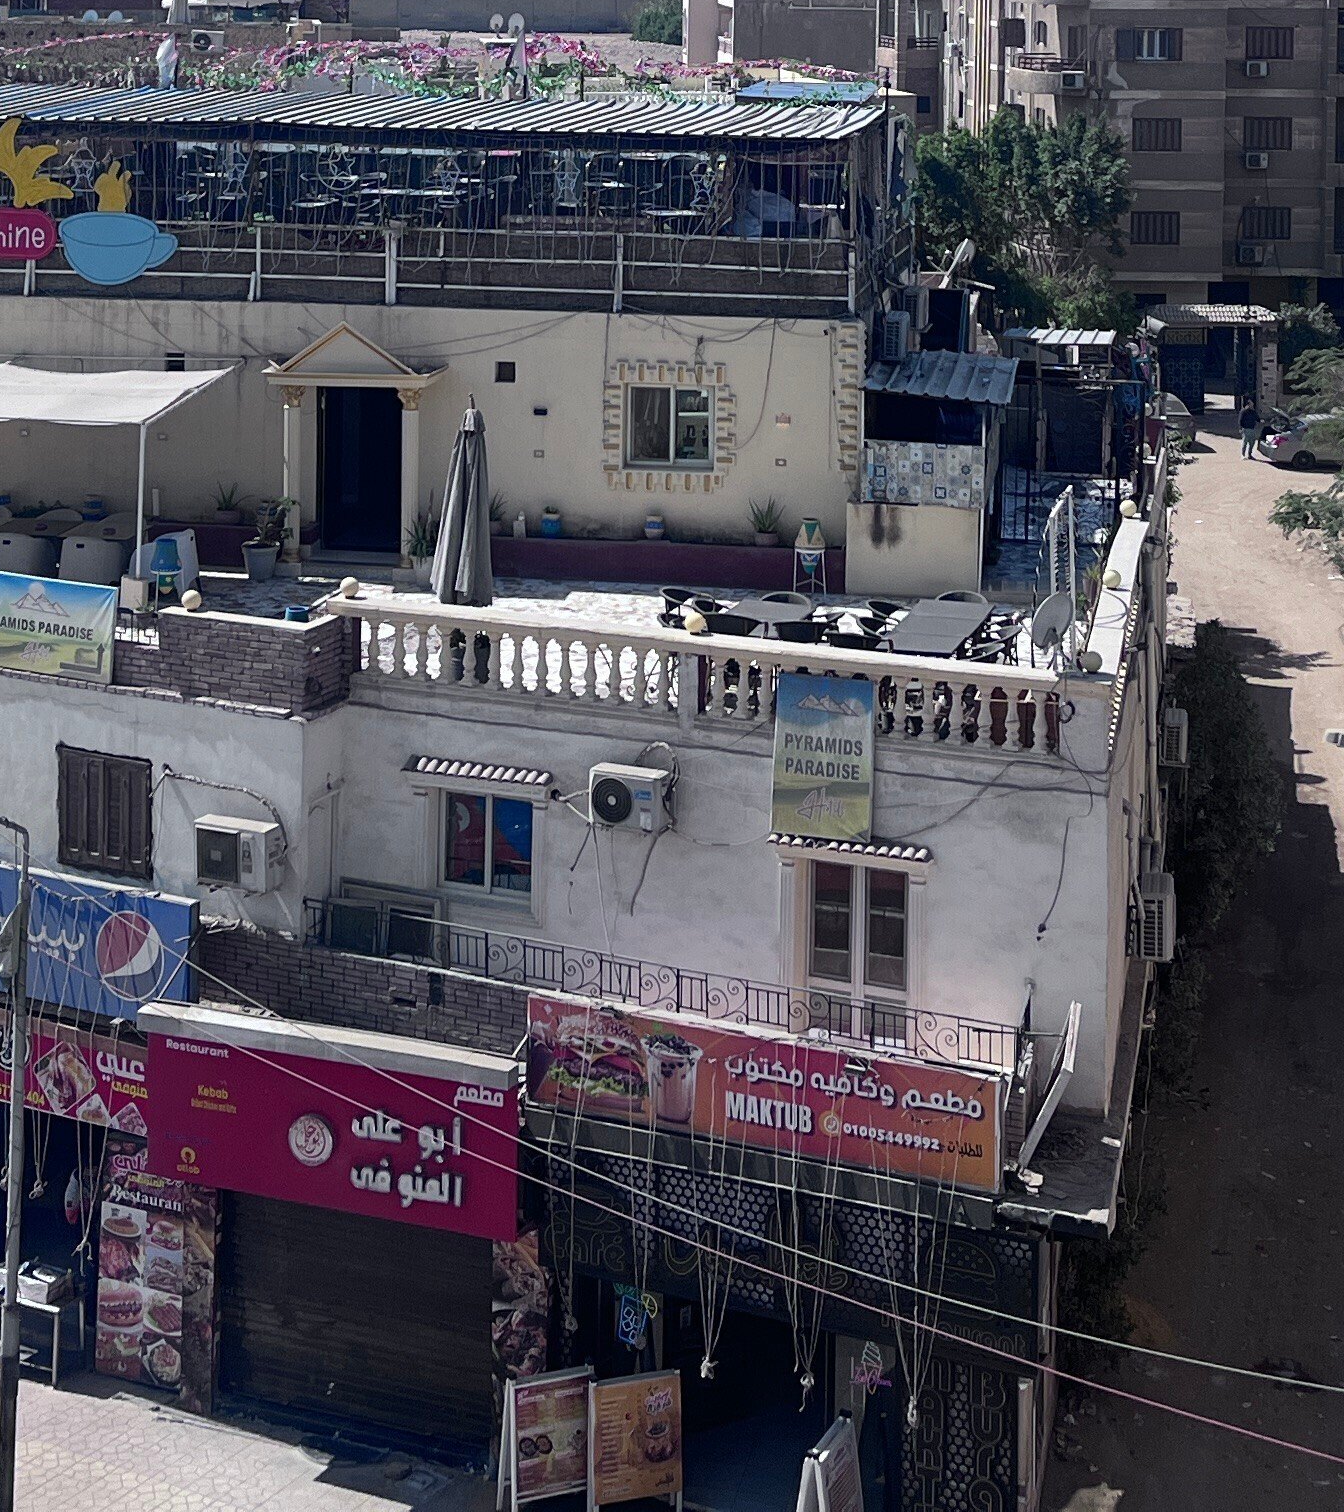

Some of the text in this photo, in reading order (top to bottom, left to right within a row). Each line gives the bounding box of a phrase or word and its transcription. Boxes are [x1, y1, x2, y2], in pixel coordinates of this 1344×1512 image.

[37, 621, 94, 641] PARADISE
[784, 732, 863, 757] PYRAMIDS
[785, 757, 860, 781] PARADISE
[166, 1038, 229, 1058] Restaurant
[197, 1085, 229, 1100] Kebab
[453, 1085, 504, 1108] مطعم
[725, 1055, 982, 1119] مطعم وكافيه مكتوب
[725, 1090, 812, 1134] MAKTUB
[843, 1122, 941, 1150] 01005449992
